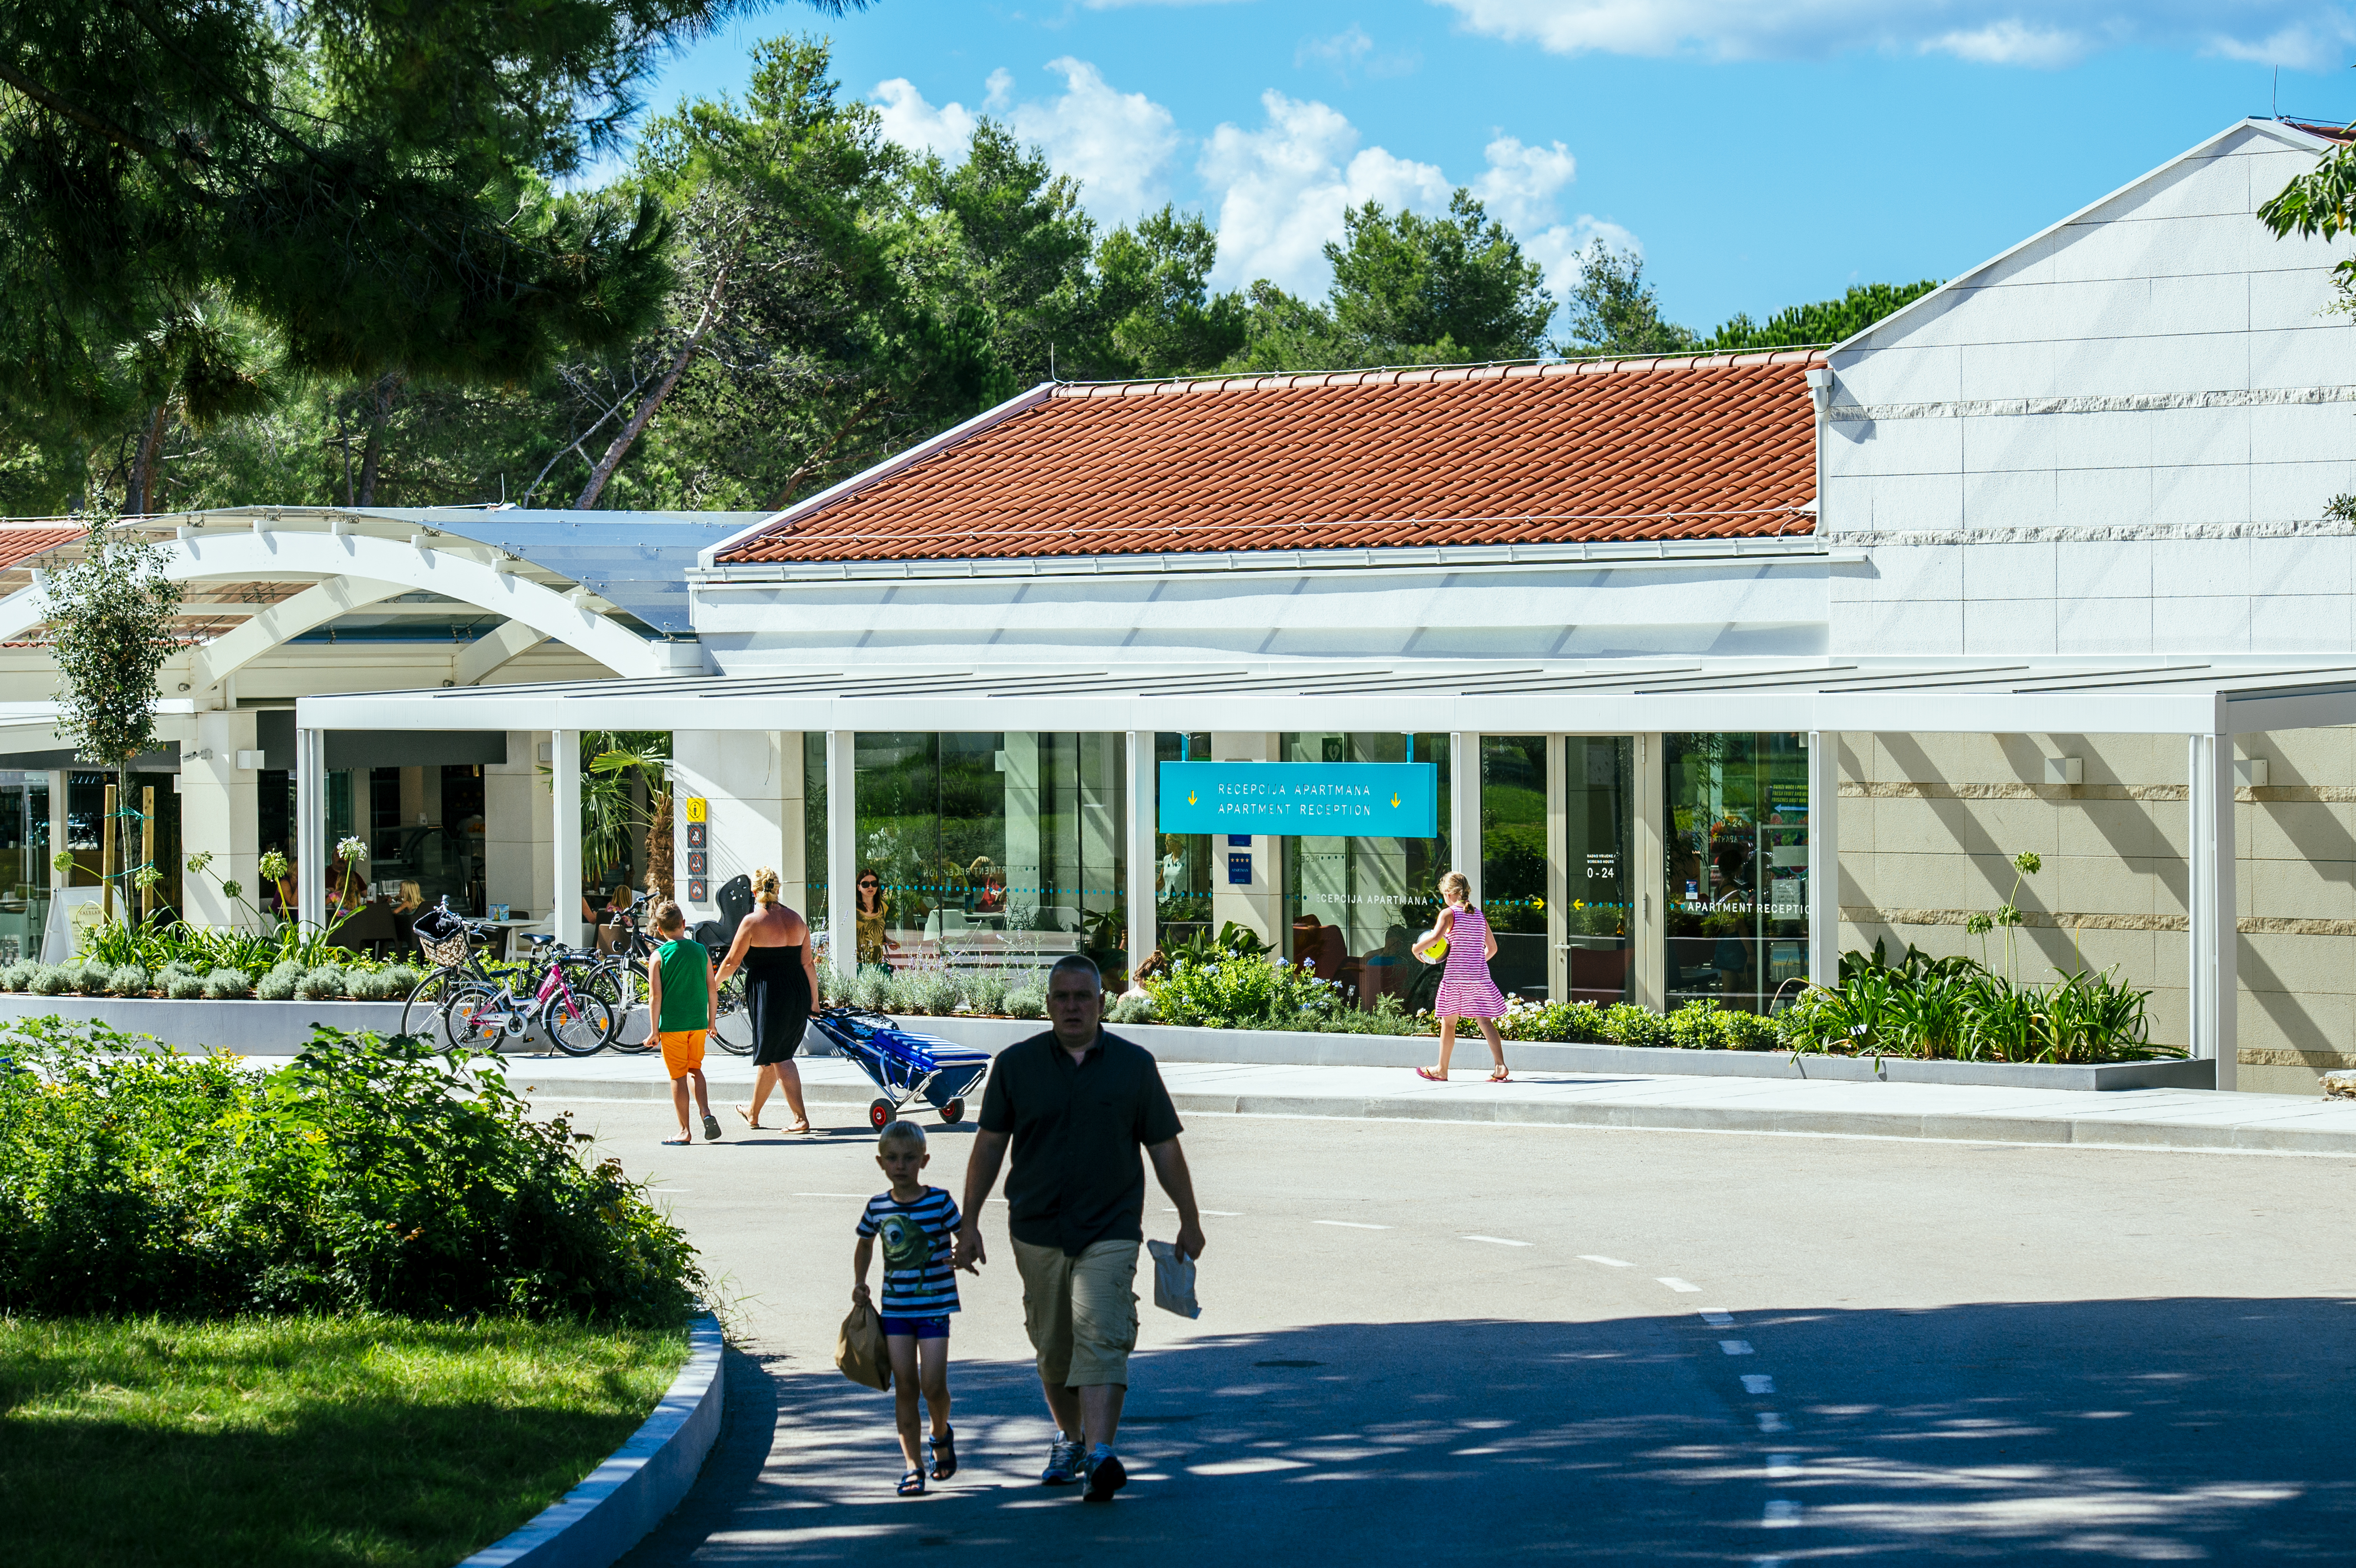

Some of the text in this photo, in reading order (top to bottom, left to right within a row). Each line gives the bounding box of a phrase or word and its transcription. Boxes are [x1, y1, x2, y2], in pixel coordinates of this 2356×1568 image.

[1218, 784, 1370, 795] RECEPCIJA APARTMANA
[1218, 803, 1370, 816] APARTMENT RECEPTION
[1587, 867, 1593, 878] 0
[1602, 867, 1614, 878] 24
[1308, 893, 1428, 905] RECEPCIJA APARTMANA
[1687, 902, 1753, 913] APARTMENT
